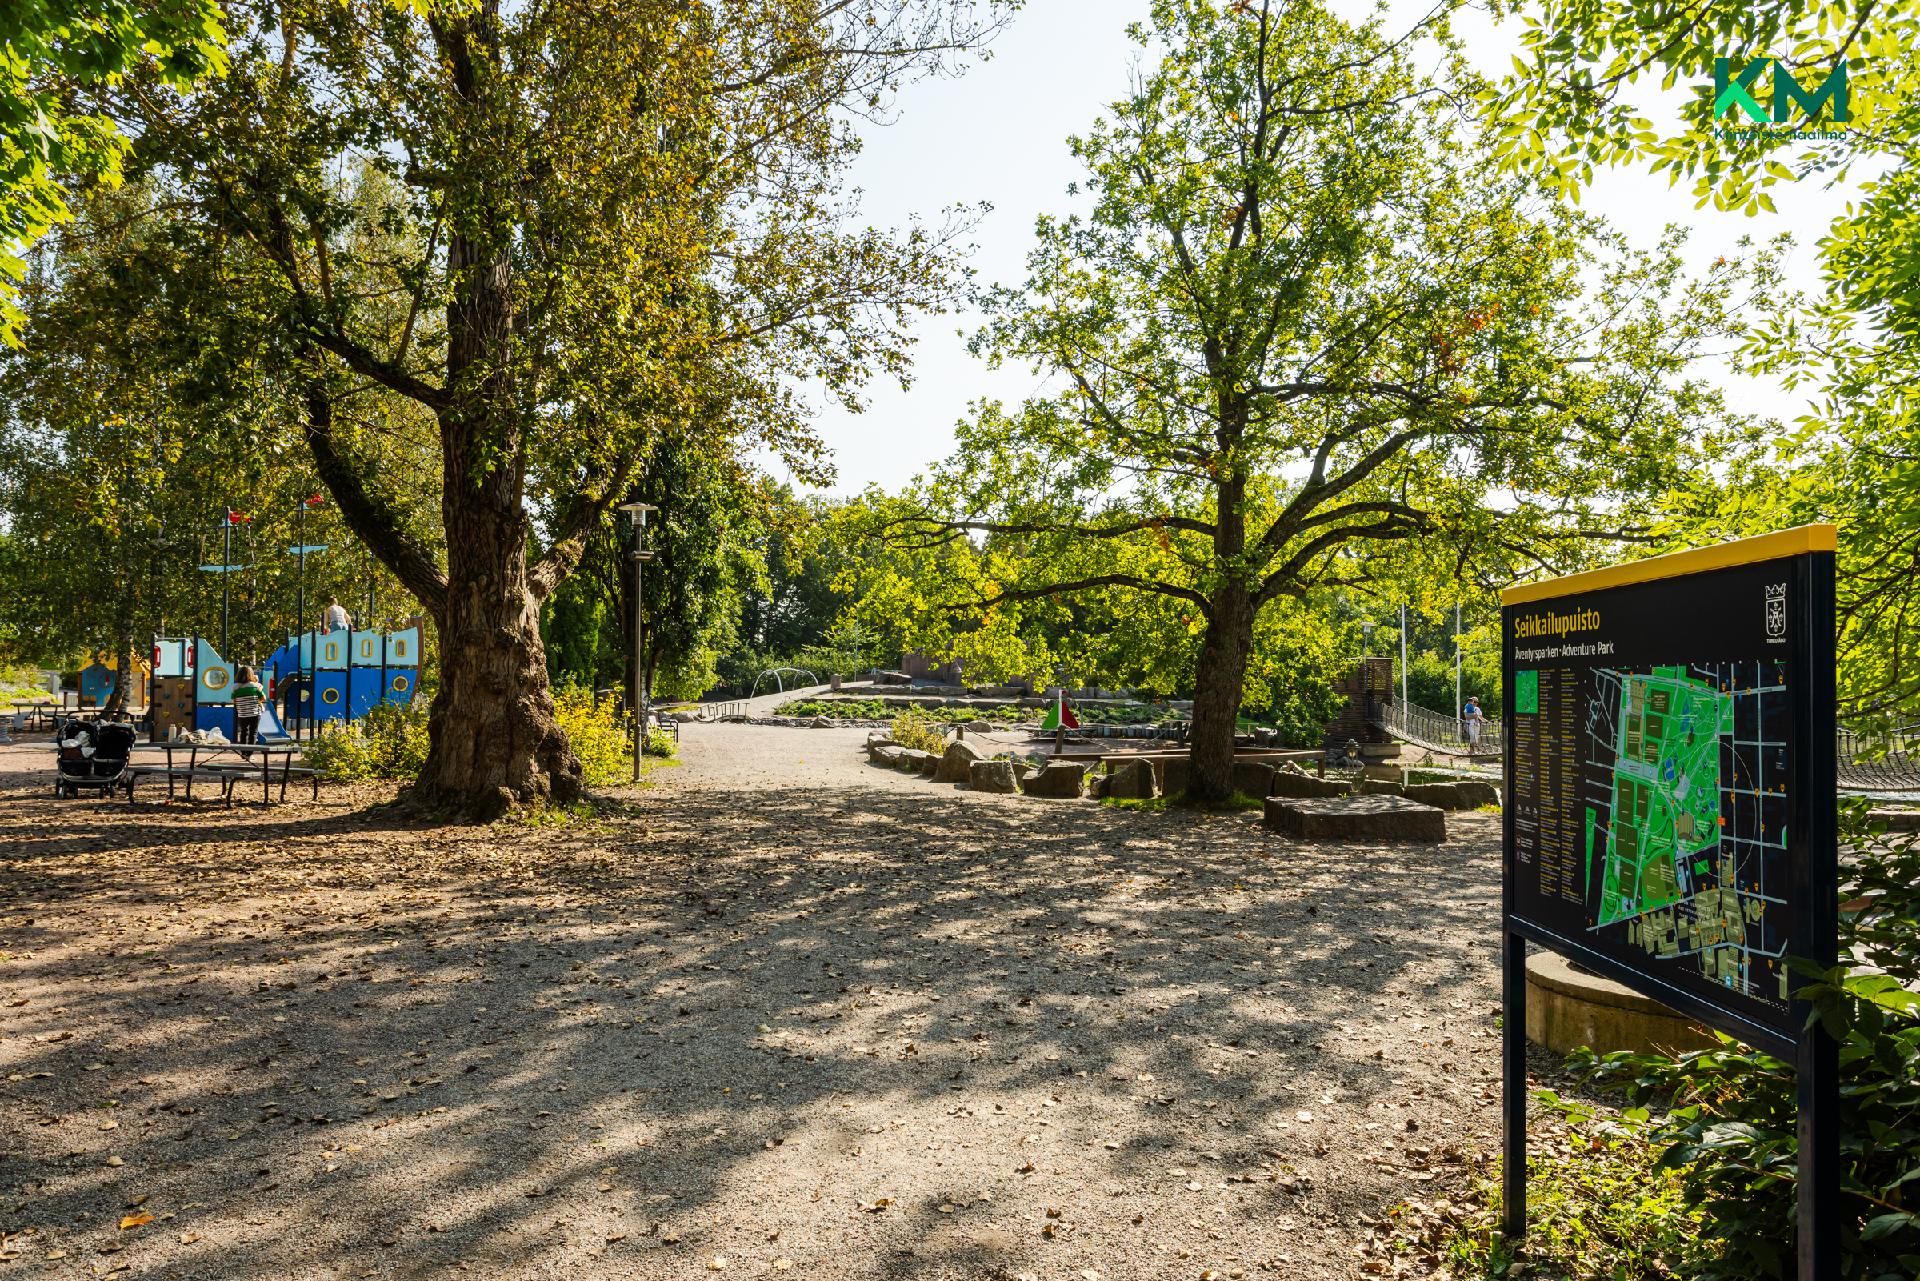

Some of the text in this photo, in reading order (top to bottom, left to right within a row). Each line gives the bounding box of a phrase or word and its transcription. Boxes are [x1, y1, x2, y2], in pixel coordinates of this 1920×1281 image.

[1515, 606, 1600, 638] Seikkailupuisto
[1562, 642, 1596, 657] Adventure
[1597, 640, 1614, 655] Park
